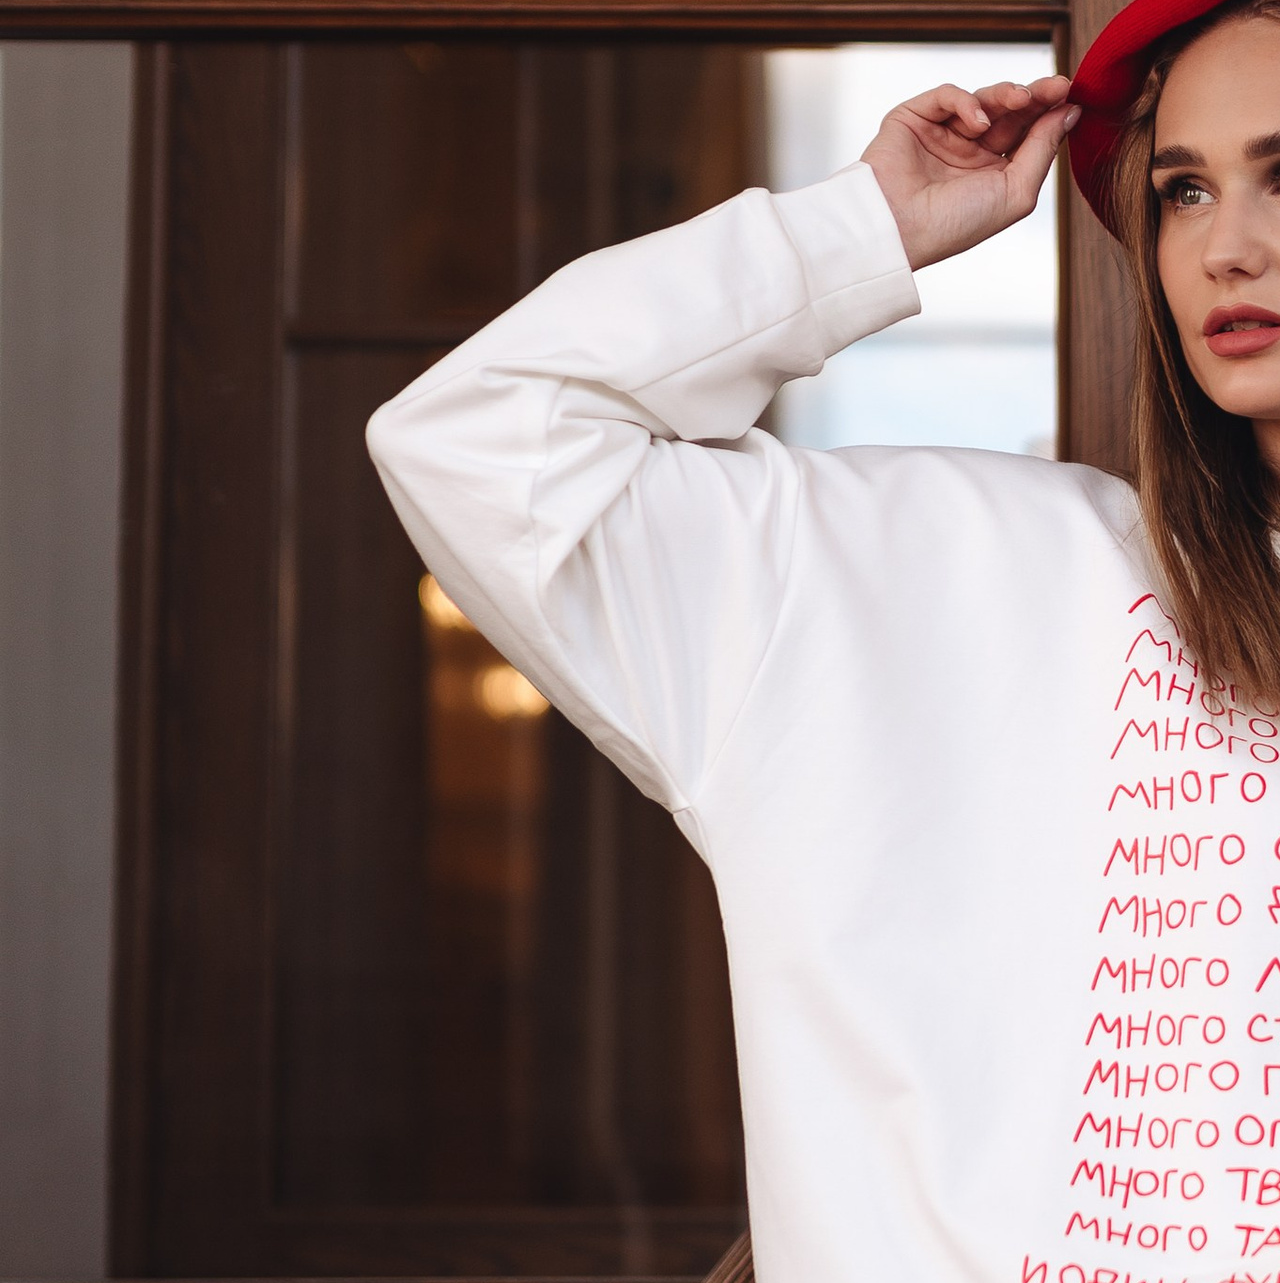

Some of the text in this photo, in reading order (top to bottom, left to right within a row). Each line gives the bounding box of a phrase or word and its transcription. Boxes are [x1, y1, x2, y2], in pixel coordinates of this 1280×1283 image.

[1113, 667, 1279, 738] МНОГО
[1110, 716, 1280, 765] МНОГО
[1107, 769, 1268, 812] МНОГО
[1102, 832, 1246, 878] МНОГО
[1097, 892, 1243, 939] МНОГО
[1090, 952, 1230, 995] МНОГО
[1084, 1009, 1227, 1050] МНОГО
[1082, 1058, 1241, 1100] МНОГО
[1072, 1111, 1221, 1150] МНОГО
[1069, 1158, 1205, 1210] МНОГО
[1064, 1211, 1209, 1253] МНОГО
